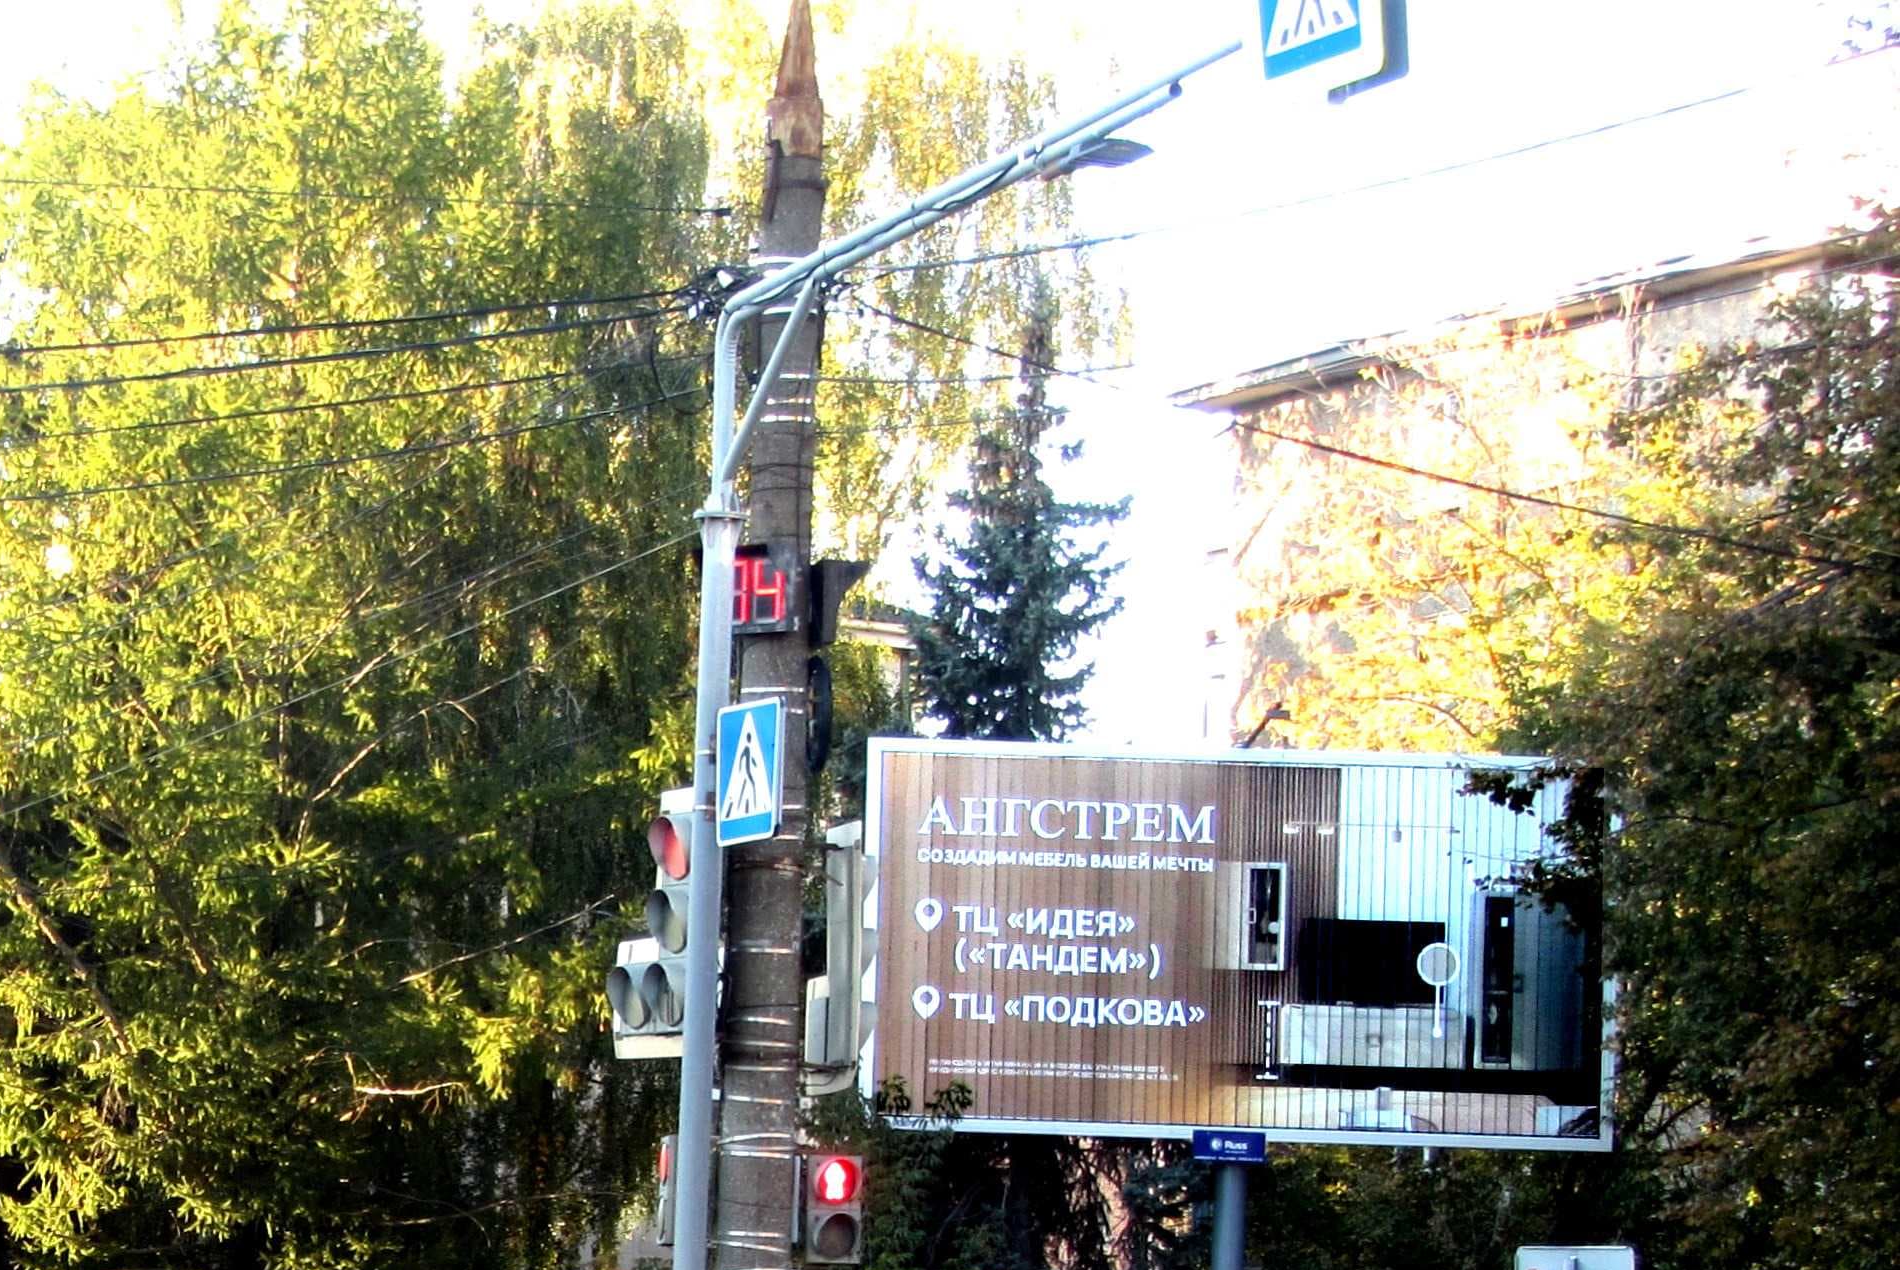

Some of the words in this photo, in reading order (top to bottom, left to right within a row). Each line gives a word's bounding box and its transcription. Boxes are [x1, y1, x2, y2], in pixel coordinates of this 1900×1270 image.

[918, 795, 1216, 844] АНГСТРЕМ
[917, 847, 1018, 867] СОЗДАДИМ
[1019, 852, 1087, 868] МЕБЕЛЬ
[1090, 851, 1150, 870] ВАШЕЙ
[1152, 856, 1215, 872] МЕЧТЫ
[952, 905, 999, 937] ТЦ
[1006, 907, 1136, 939] «ИДЕЯ»
[954, 937, 1162, 980] («ТАНДЕМ»)
[948, 992, 996, 1024] ТЦ
[1003, 995, 1206, 1028] «ПОДКОВА»
